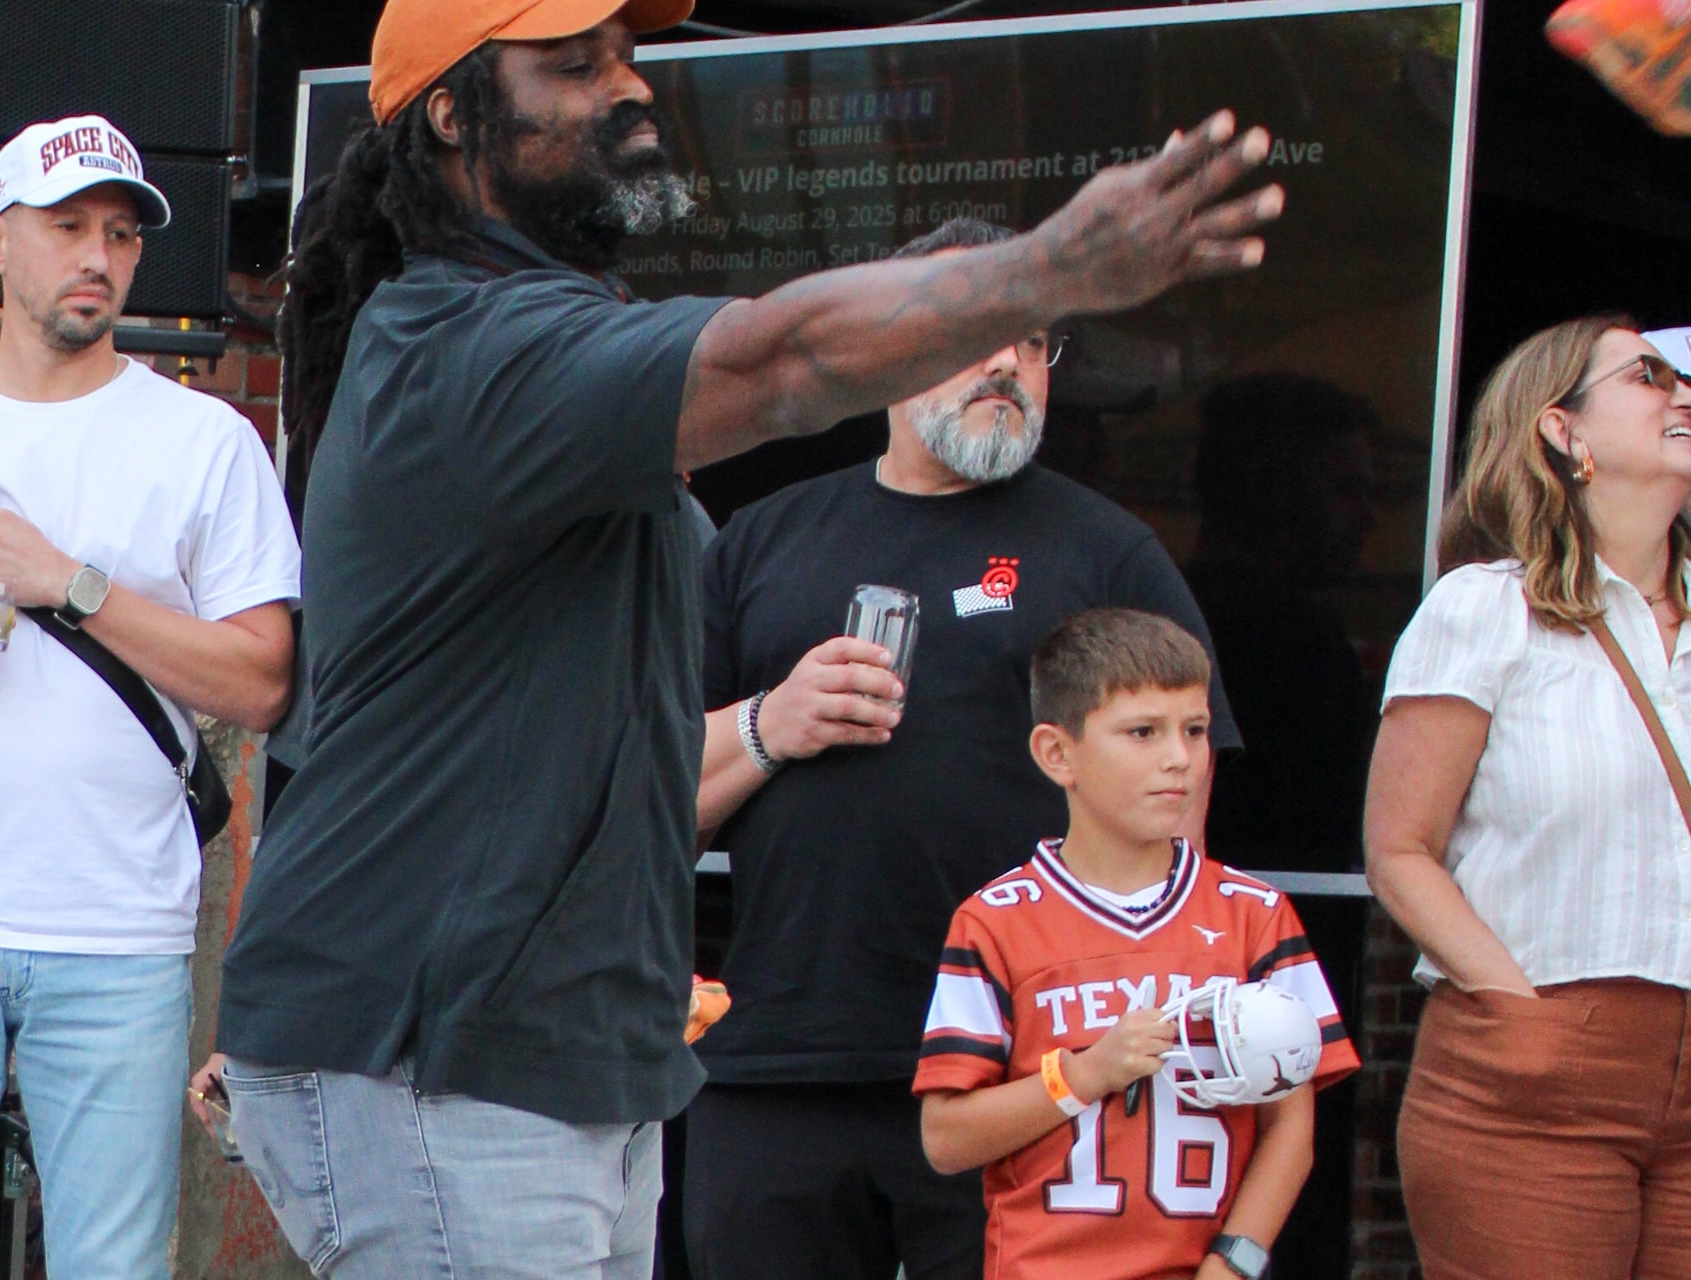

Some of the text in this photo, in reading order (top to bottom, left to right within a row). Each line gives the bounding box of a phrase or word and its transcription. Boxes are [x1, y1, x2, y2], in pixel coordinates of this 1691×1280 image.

[41, 126, 104, 176] SPACE
[797, 124, 885, 148] CORNHOLE
[737, 166, 779, 194] VIP
[786, 160, 889, 197] legends
[896, 150, 1064, 188] tournament
[1071, 150, 1101, 177] at
[1267, 138, 1325, 167] Ave
[671, 214, 731, 240] Friday
[737, 211, 806, 238] August
[811, 208, 840, 232] 29,
[847, 204, 896, 228] 2025
[903, 205, 923, 225] at
[690, 249, 754, 272] Round
[1042, 1038, 1234, 1219] 16
